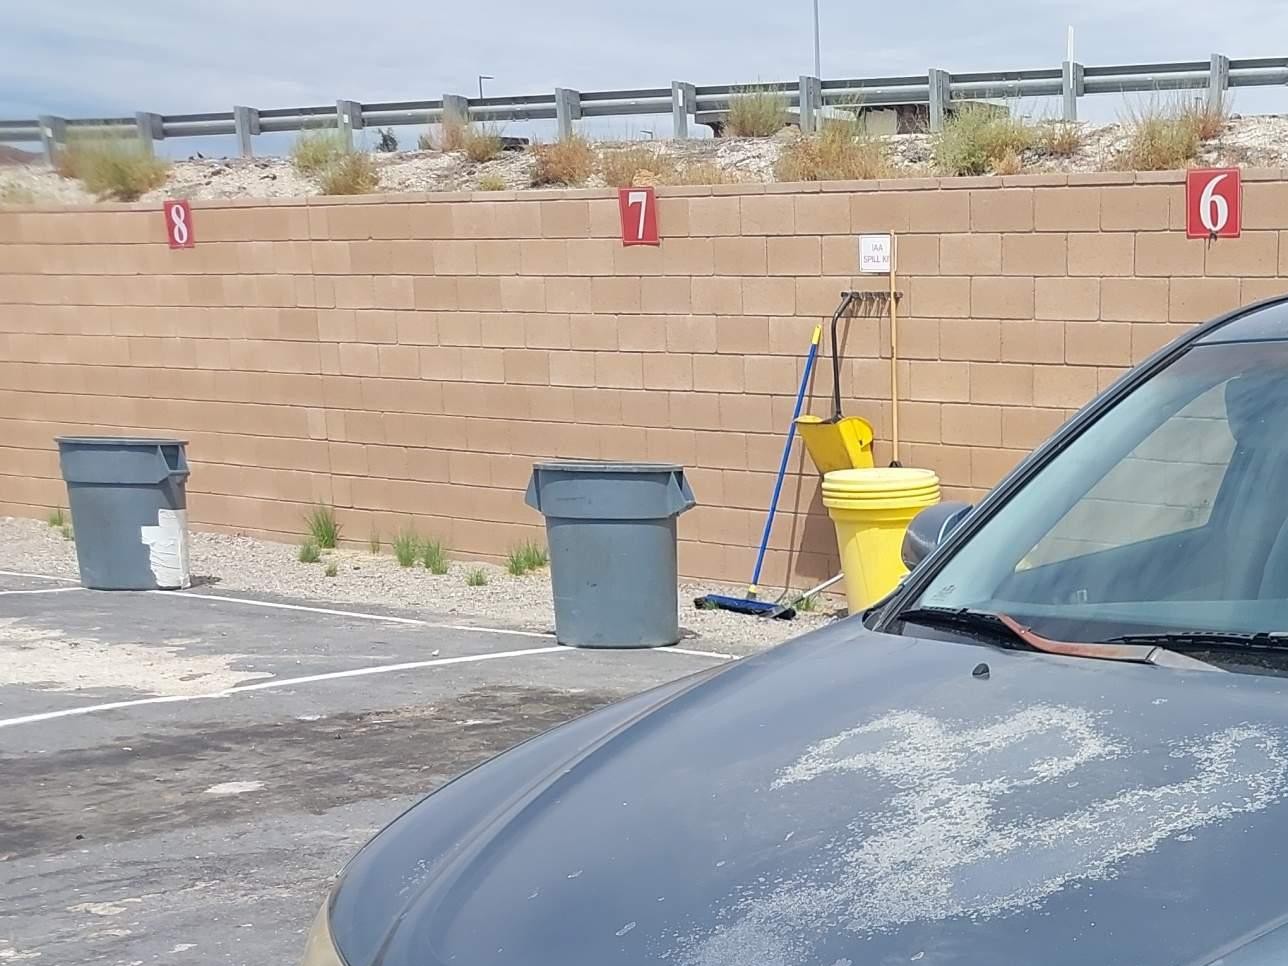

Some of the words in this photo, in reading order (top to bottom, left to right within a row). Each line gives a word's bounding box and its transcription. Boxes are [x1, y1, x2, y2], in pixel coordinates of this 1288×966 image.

[628, 191, 647, 239] 7
[1200, 174, 1228, 231] 6
[171, 204, 188, 244] 8
[863, 255, 880, 263] SPILL
[871, 243, 883, 251] IAA
